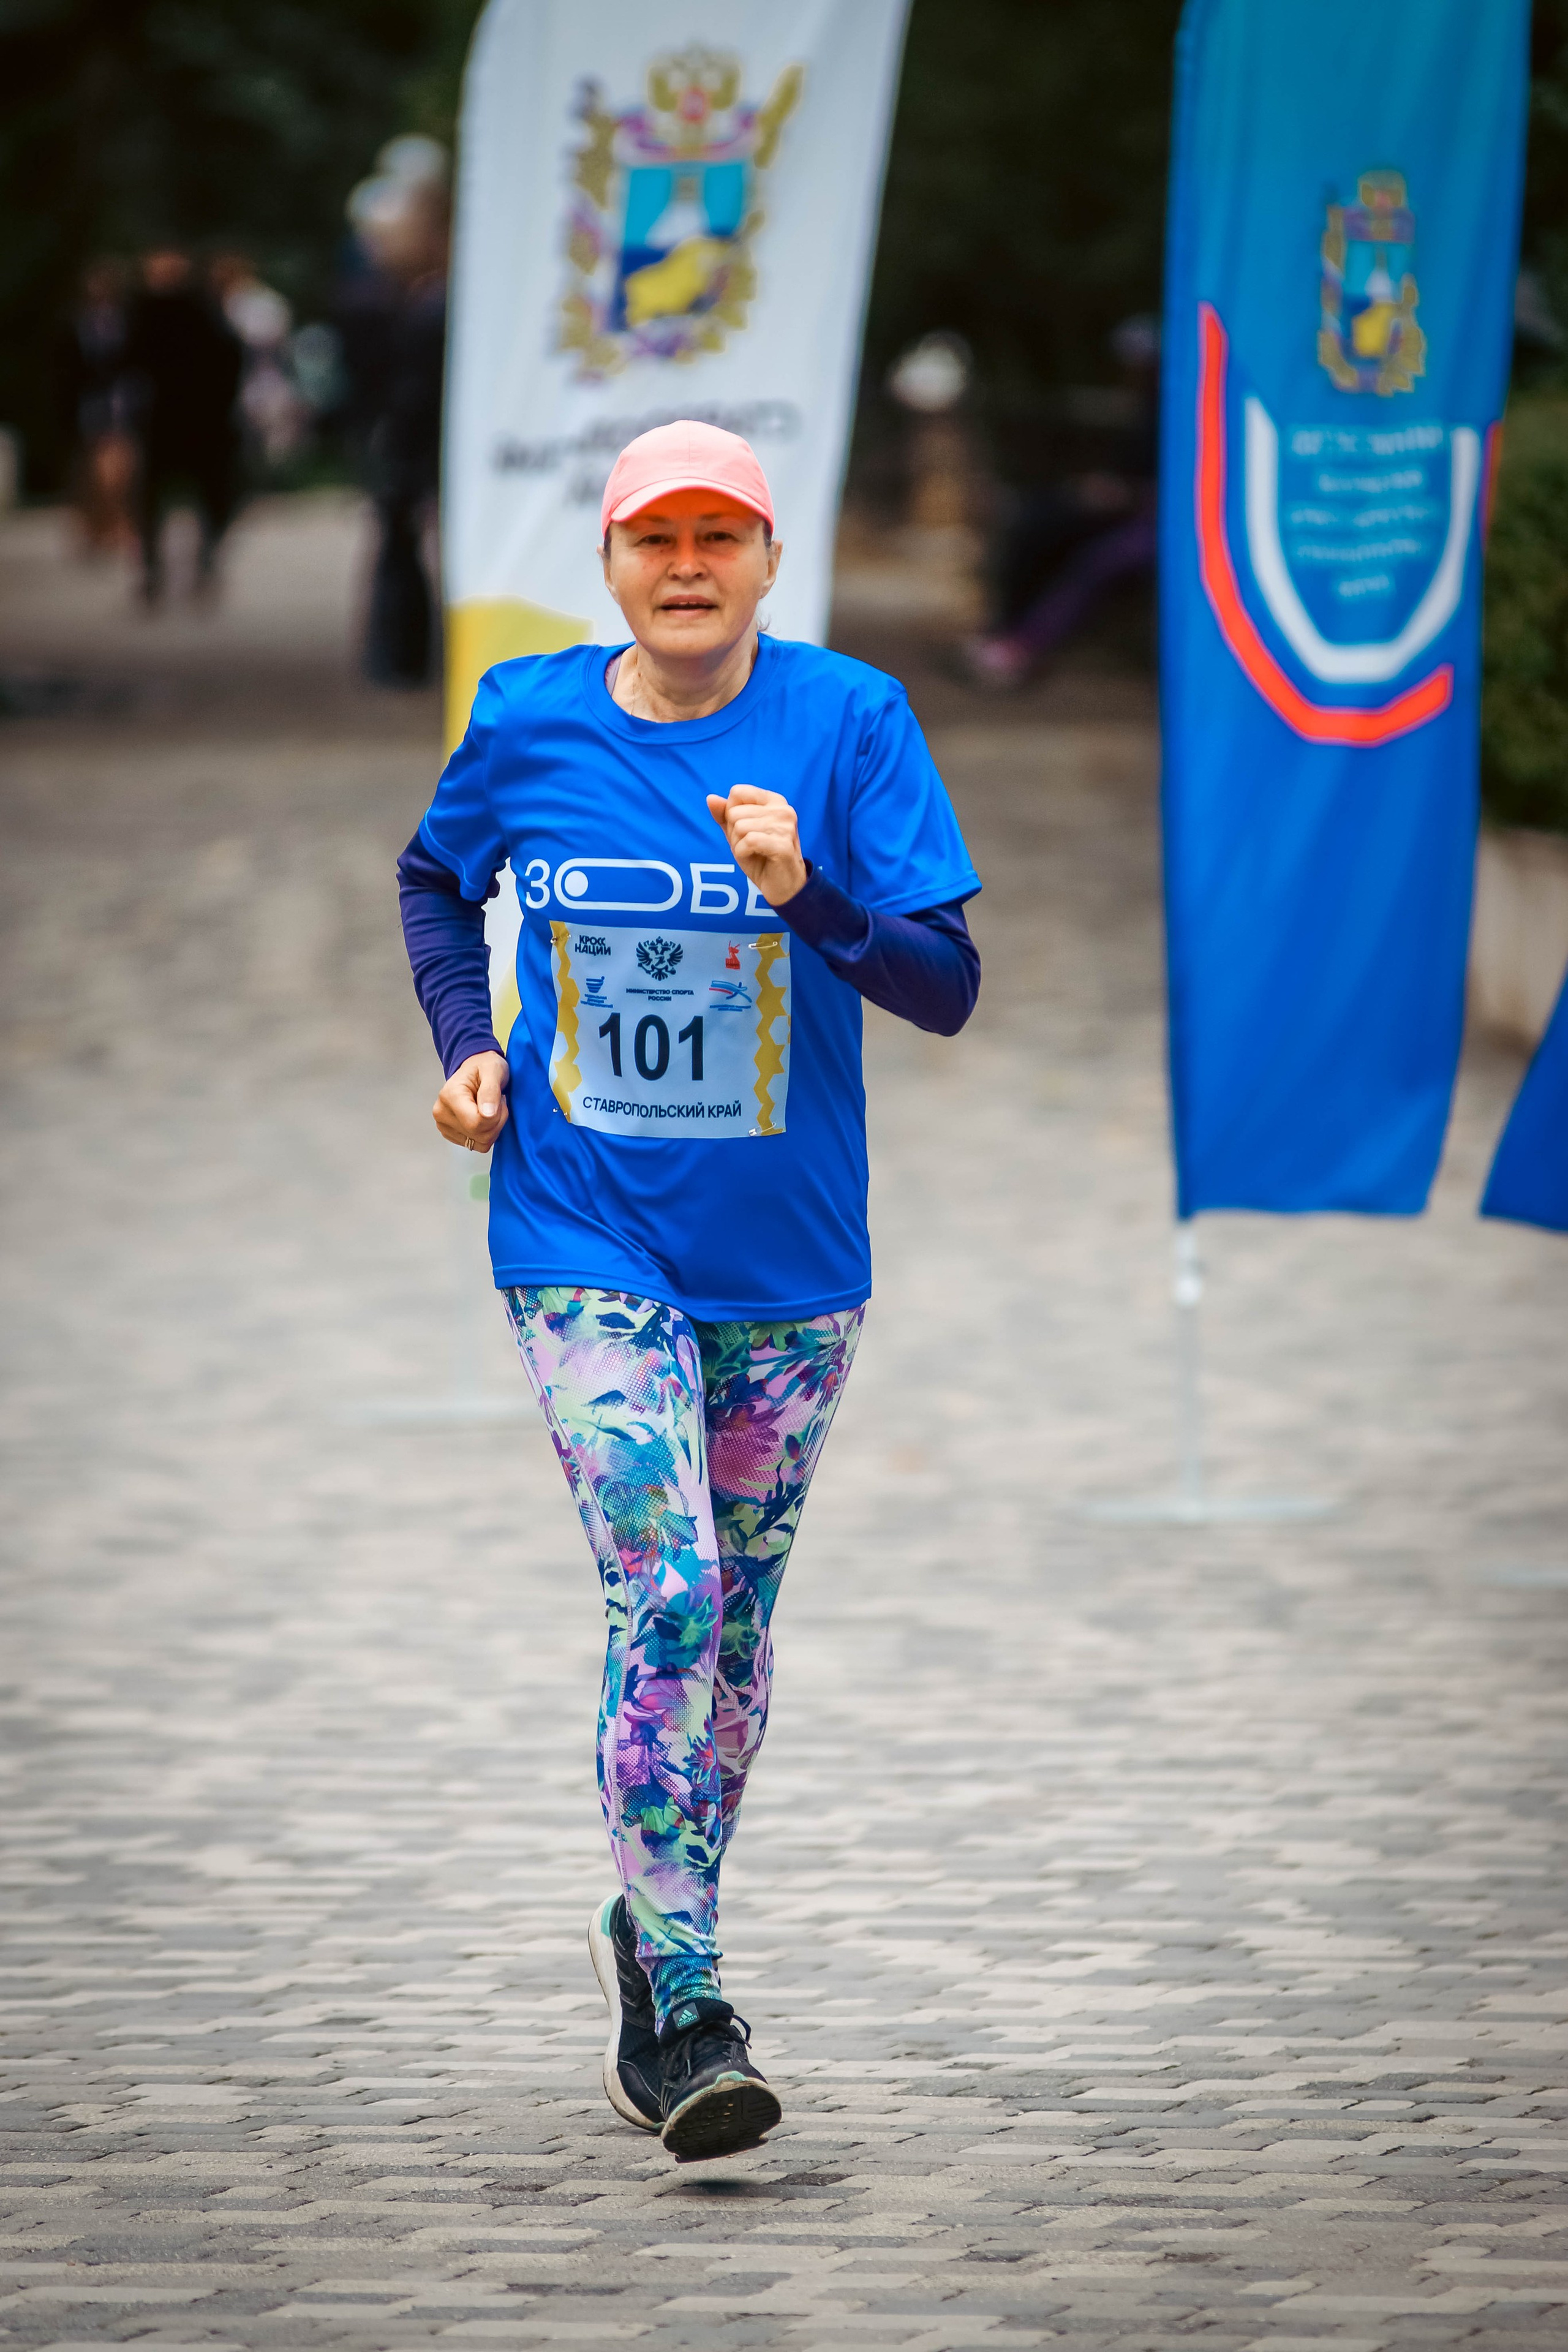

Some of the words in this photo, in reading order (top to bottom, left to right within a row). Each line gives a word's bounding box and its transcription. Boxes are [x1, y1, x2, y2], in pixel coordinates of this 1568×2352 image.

[579, 935, 606, 946] КРОСС
[575, 943, 611, 956] НАЦИИ
[599, 1012, 703, 1081] 101
[582, 1096, 704, 1118] СТАВРОПОЛЬСКИЙ
[707, 1100, 742, 1118] КРАЙ
[677, 2015, 698, 2027] adidas
